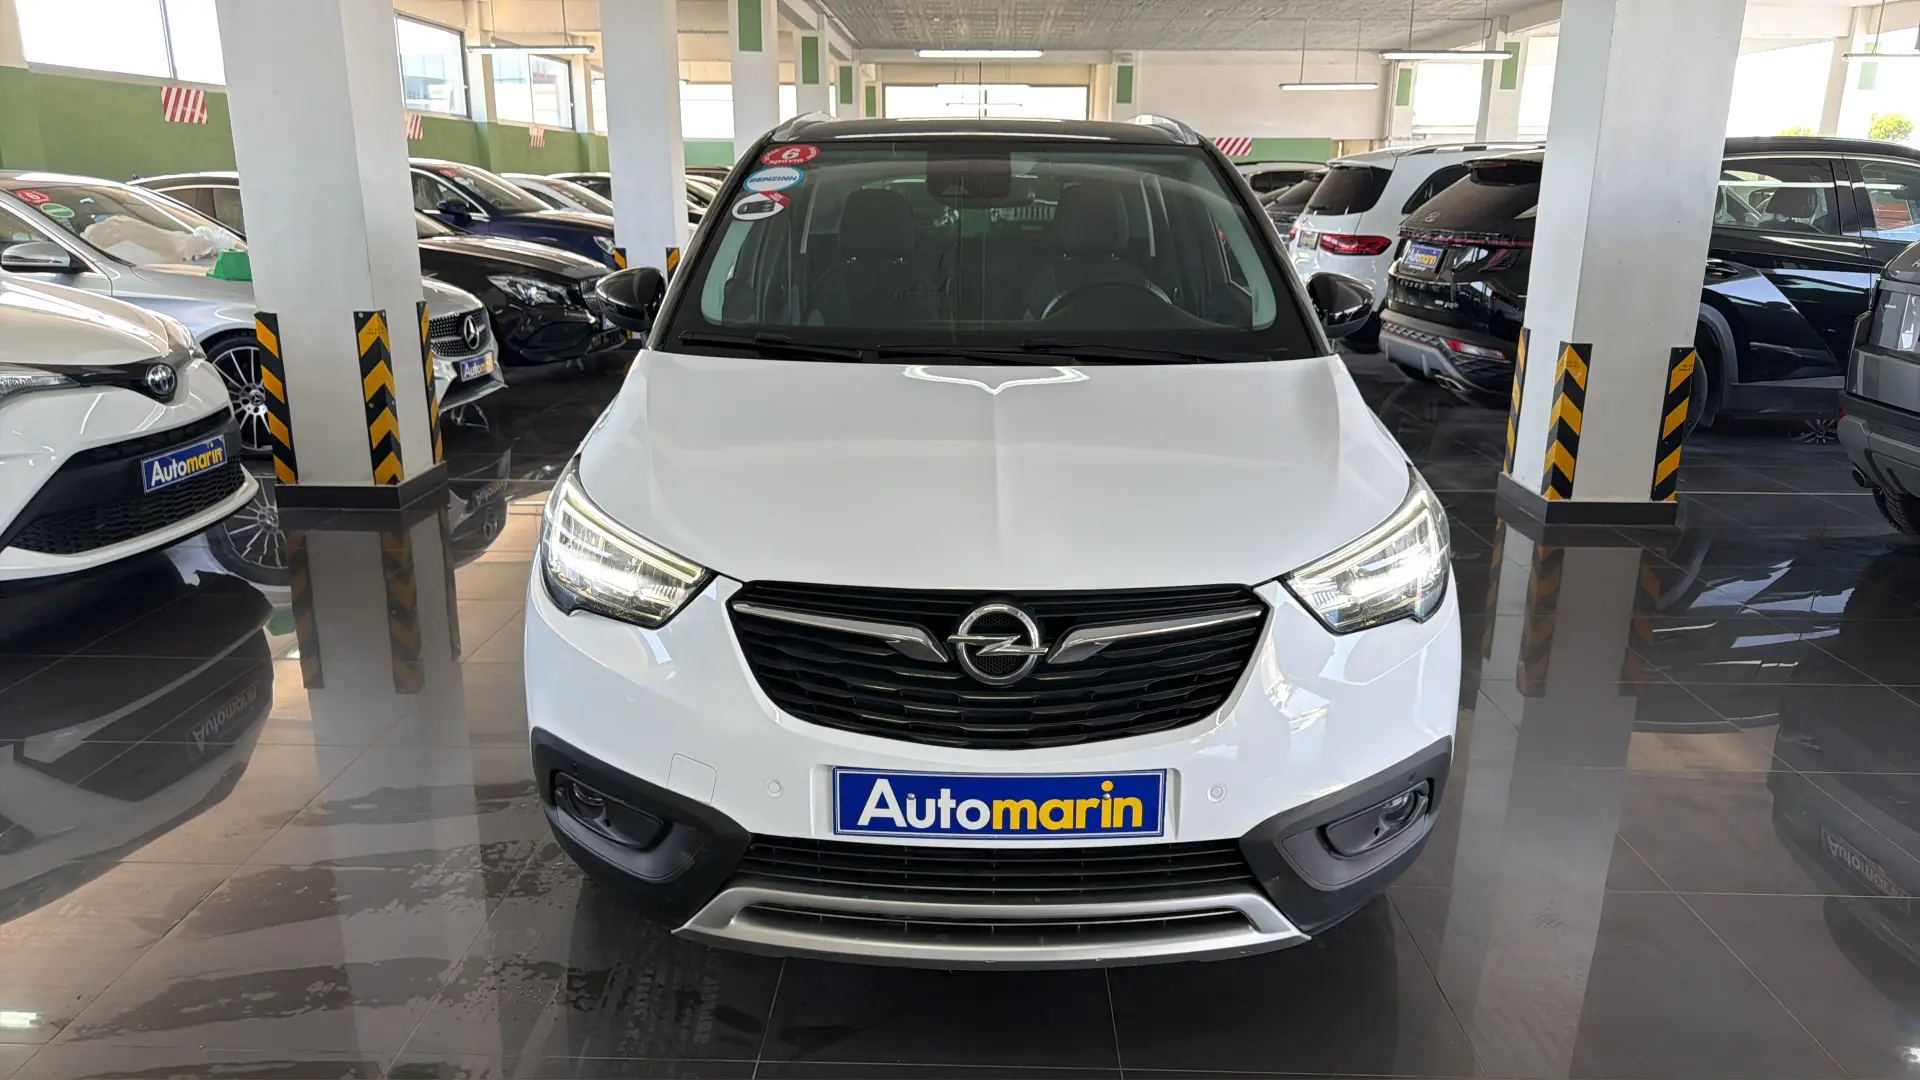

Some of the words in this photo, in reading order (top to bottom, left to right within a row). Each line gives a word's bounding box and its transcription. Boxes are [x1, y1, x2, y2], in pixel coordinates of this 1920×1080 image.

[782, 147, 801, 160] 6
[151, 441, 222, 487] Automarin
[857, 778, 1143, 830] Automarin
